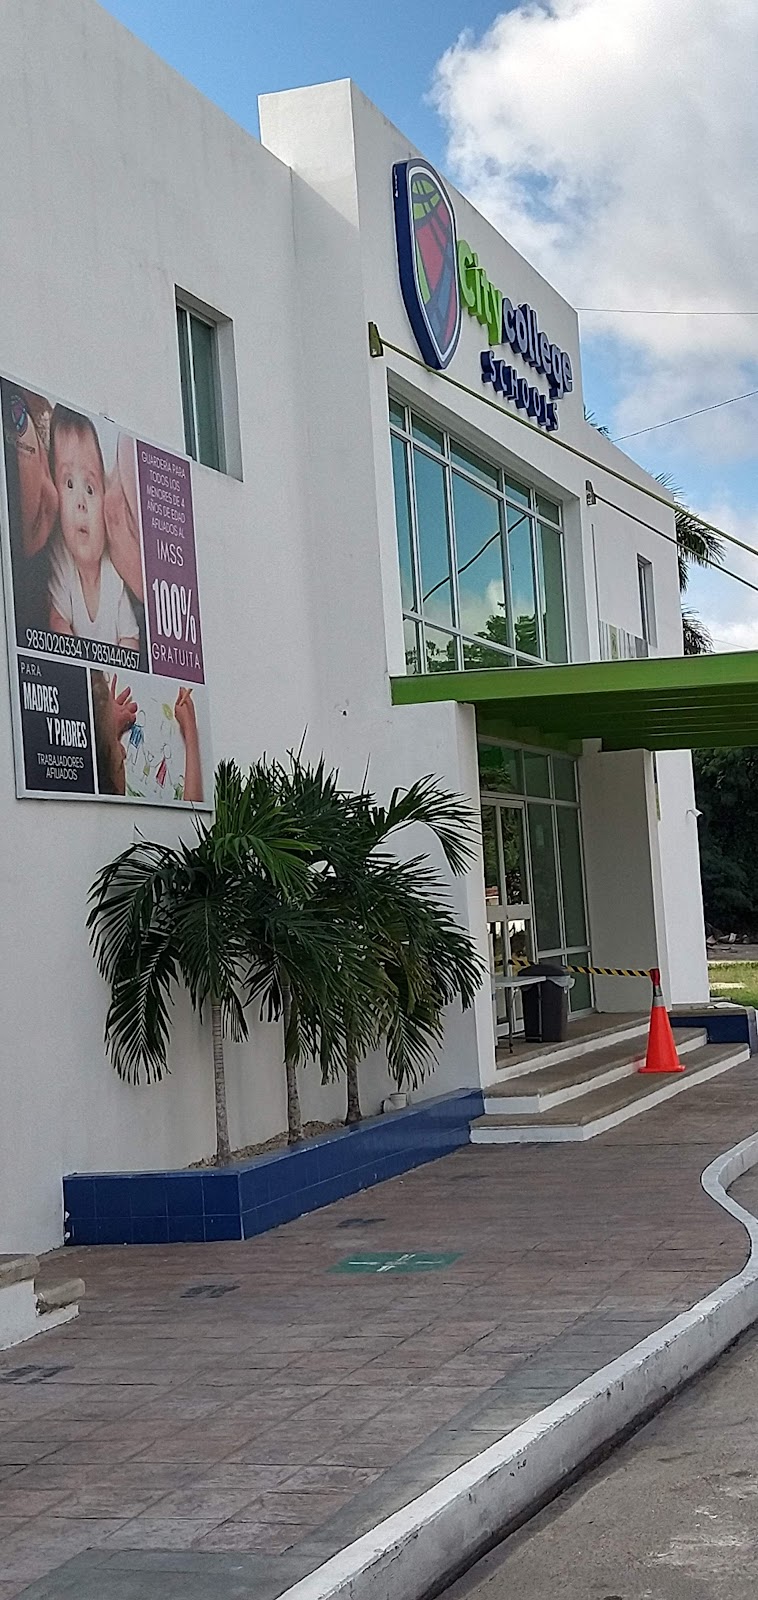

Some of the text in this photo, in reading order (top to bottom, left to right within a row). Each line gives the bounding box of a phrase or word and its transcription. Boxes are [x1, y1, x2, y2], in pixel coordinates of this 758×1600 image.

[480, 350, 559, 431] SCHOOLS
[149, 469, 181, 492] TODOS LOS
[172, 463, 186, 479] PARA
[146, 484, 172, 504] MENORES
[173, 497, 181, 507] DE
[146, 498, 186, 524] AÑOS DE EDAD
[151, 517, 178, 536] AFILIADOS
[157, 539, 184, 567] IMSS
[152, 578, 197, 645] 100%
[26, 628, 140, 670] 9831020334 Y 9831440657
[151, 642, 201, 669] GRATUITA
[20, 662, 42, 677] PARA
[23, 682, 59, 714] MADRES
[46, 717, 88, 749] Y PADRES
[37, 752, 84, 769] TRABAJADORES
[46, 767, 78, 780] AFILIADOS
